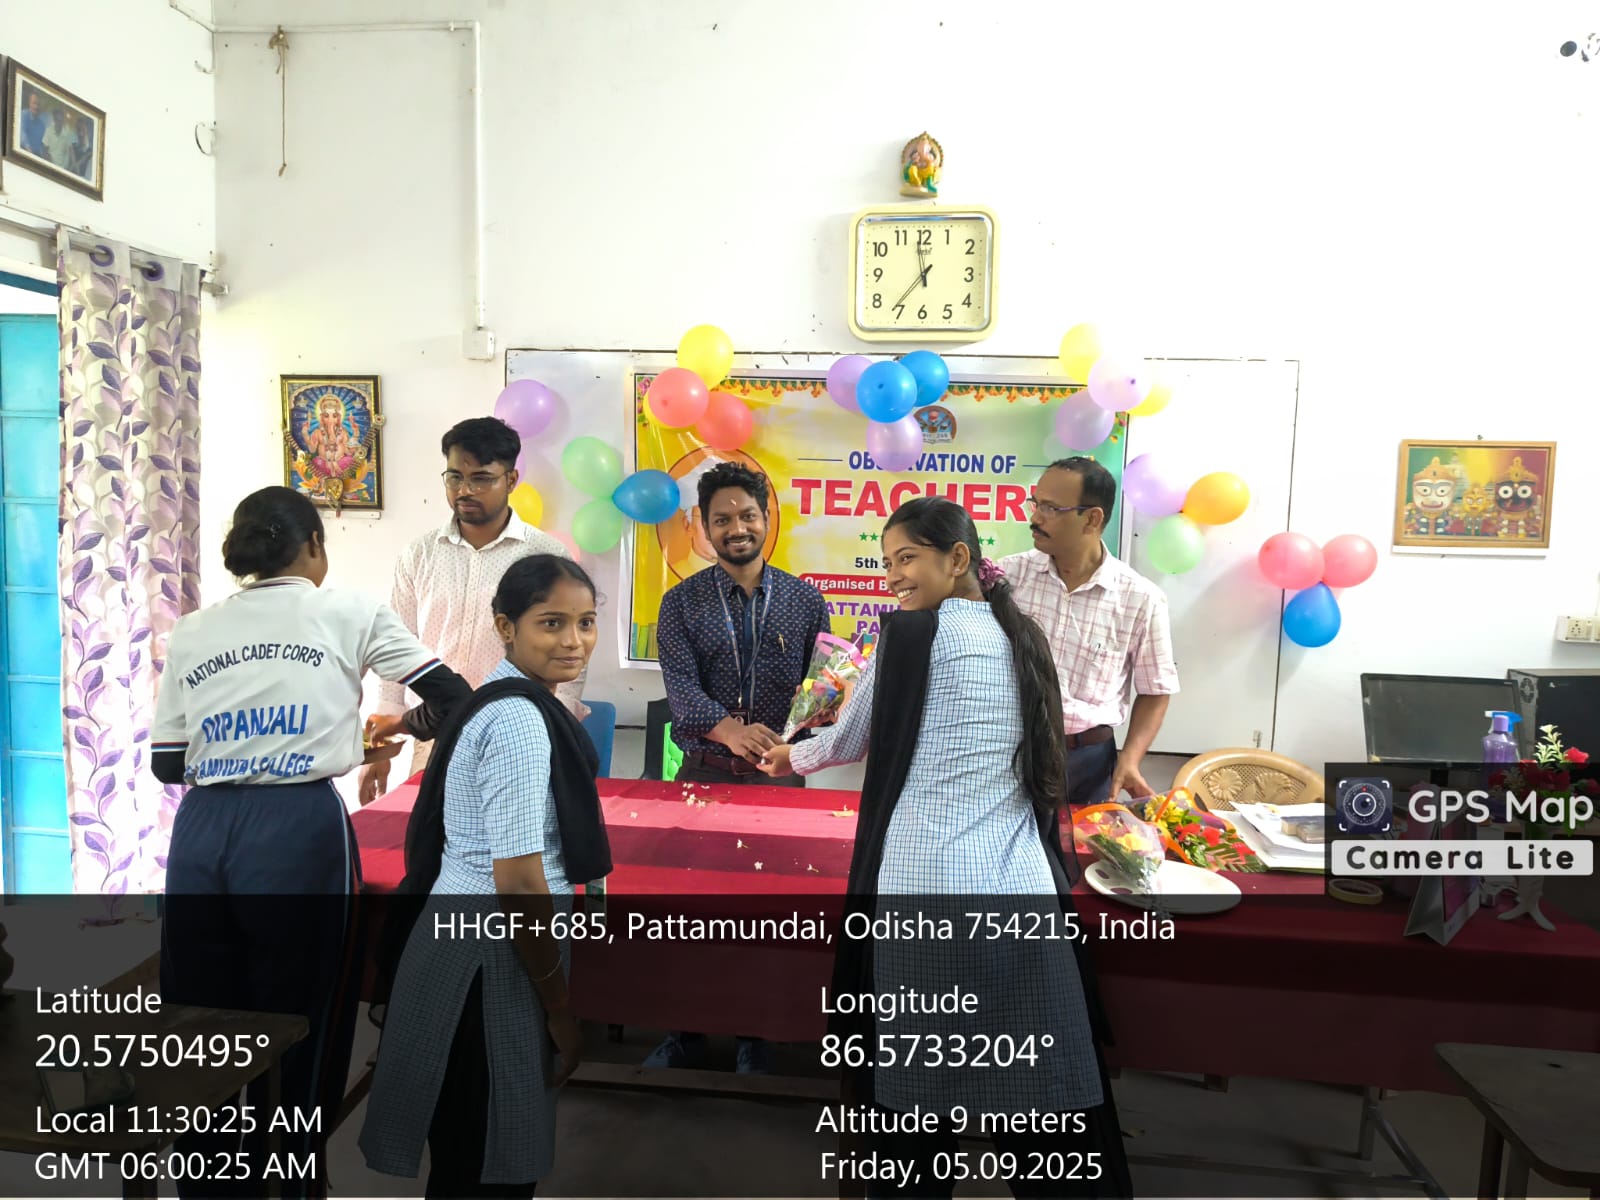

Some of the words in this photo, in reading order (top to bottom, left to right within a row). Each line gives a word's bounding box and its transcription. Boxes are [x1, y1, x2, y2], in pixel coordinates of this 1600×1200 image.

[894, 229, 908, 246] 11
[916, 229, 932, 246] 12
[944, 229, 950, 245] 1
[872, 241, 888, 257] 10
[964, 239, 976, 255] 2
[873, 267, 883, 283] 9
[963, 267, 974, 282] 3
[872, 293, 882, 309] 8
[961, 292, 972, 308] 4
[895, 304, 906, 320] 7
[917, 304, 928, 320] 6
[942, 304, 953, 320] 5
[848, 450, 985, 474] OBVATION
[990, 454, 1017, 475] OF
[791, 478, 1038, 523] TEACER
[854, 556, 879, 569] 5th
[804, 576, 875, 591] Organised
[186, 649, 240, 690] NATIONAL
[242, 643, 281, 662] CADET
[282, 644, 324, 668] CORPS
[201, 704, 309, 744] DIPANJALI
